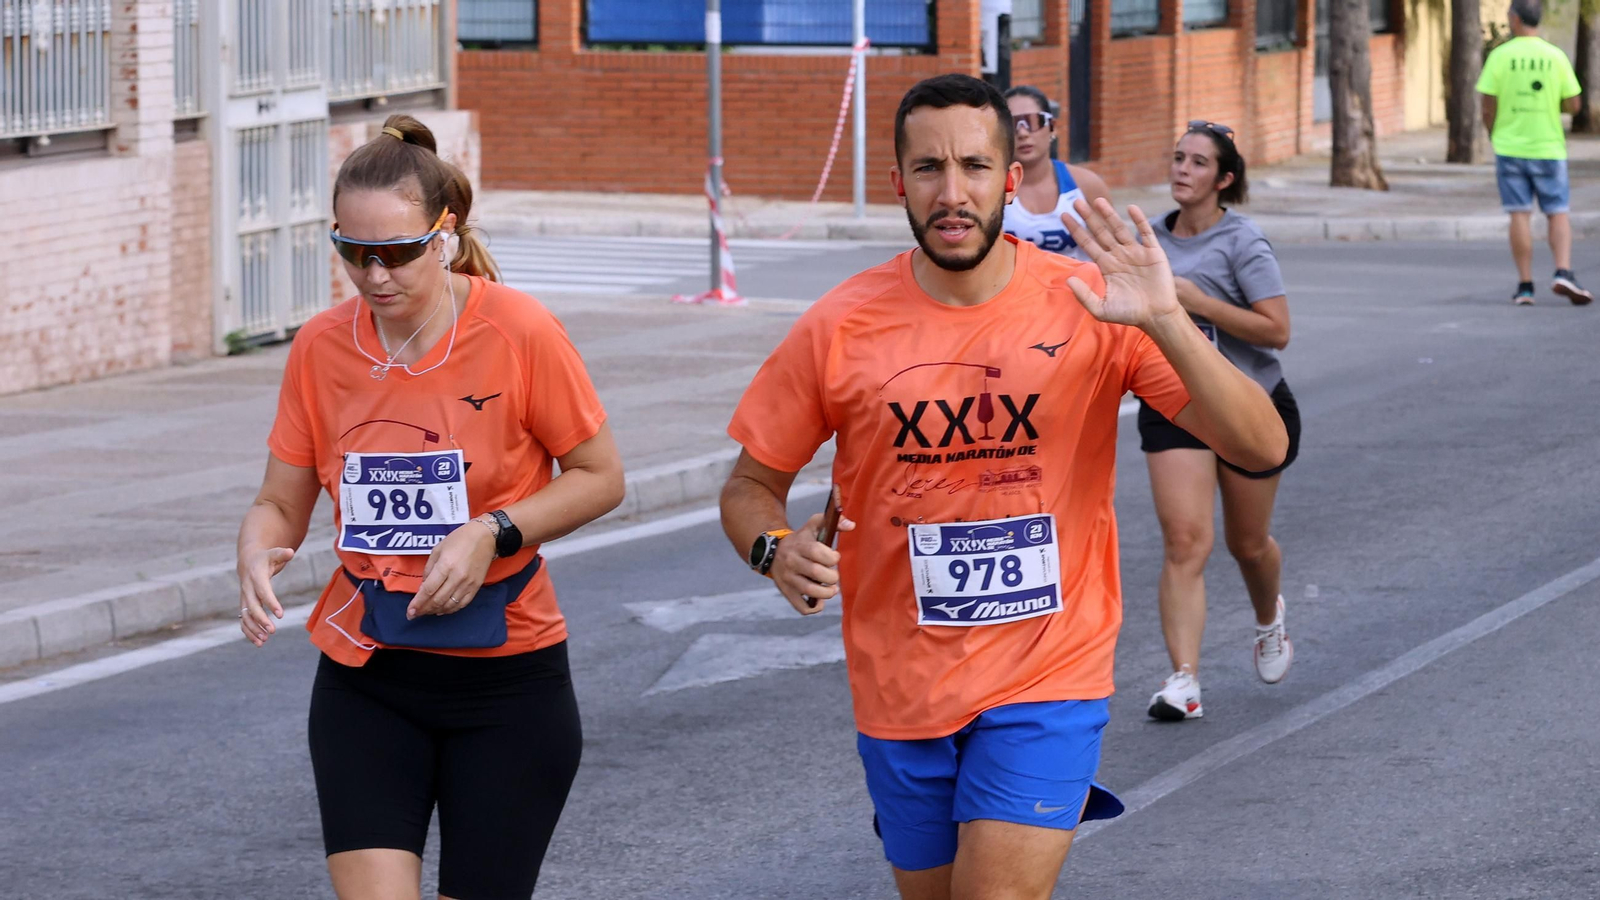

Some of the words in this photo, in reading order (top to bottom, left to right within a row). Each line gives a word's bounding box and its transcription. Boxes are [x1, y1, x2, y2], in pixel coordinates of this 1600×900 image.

[897, 453, 942, 464] MEDIA
[1017, 445, 1038, 456] DE
[438, 462, 450, 471] 21
[367, 489, 433, 520] 986
[1030, 524, 1043, 534] 21
[948, 555, 1023, 592] 978
